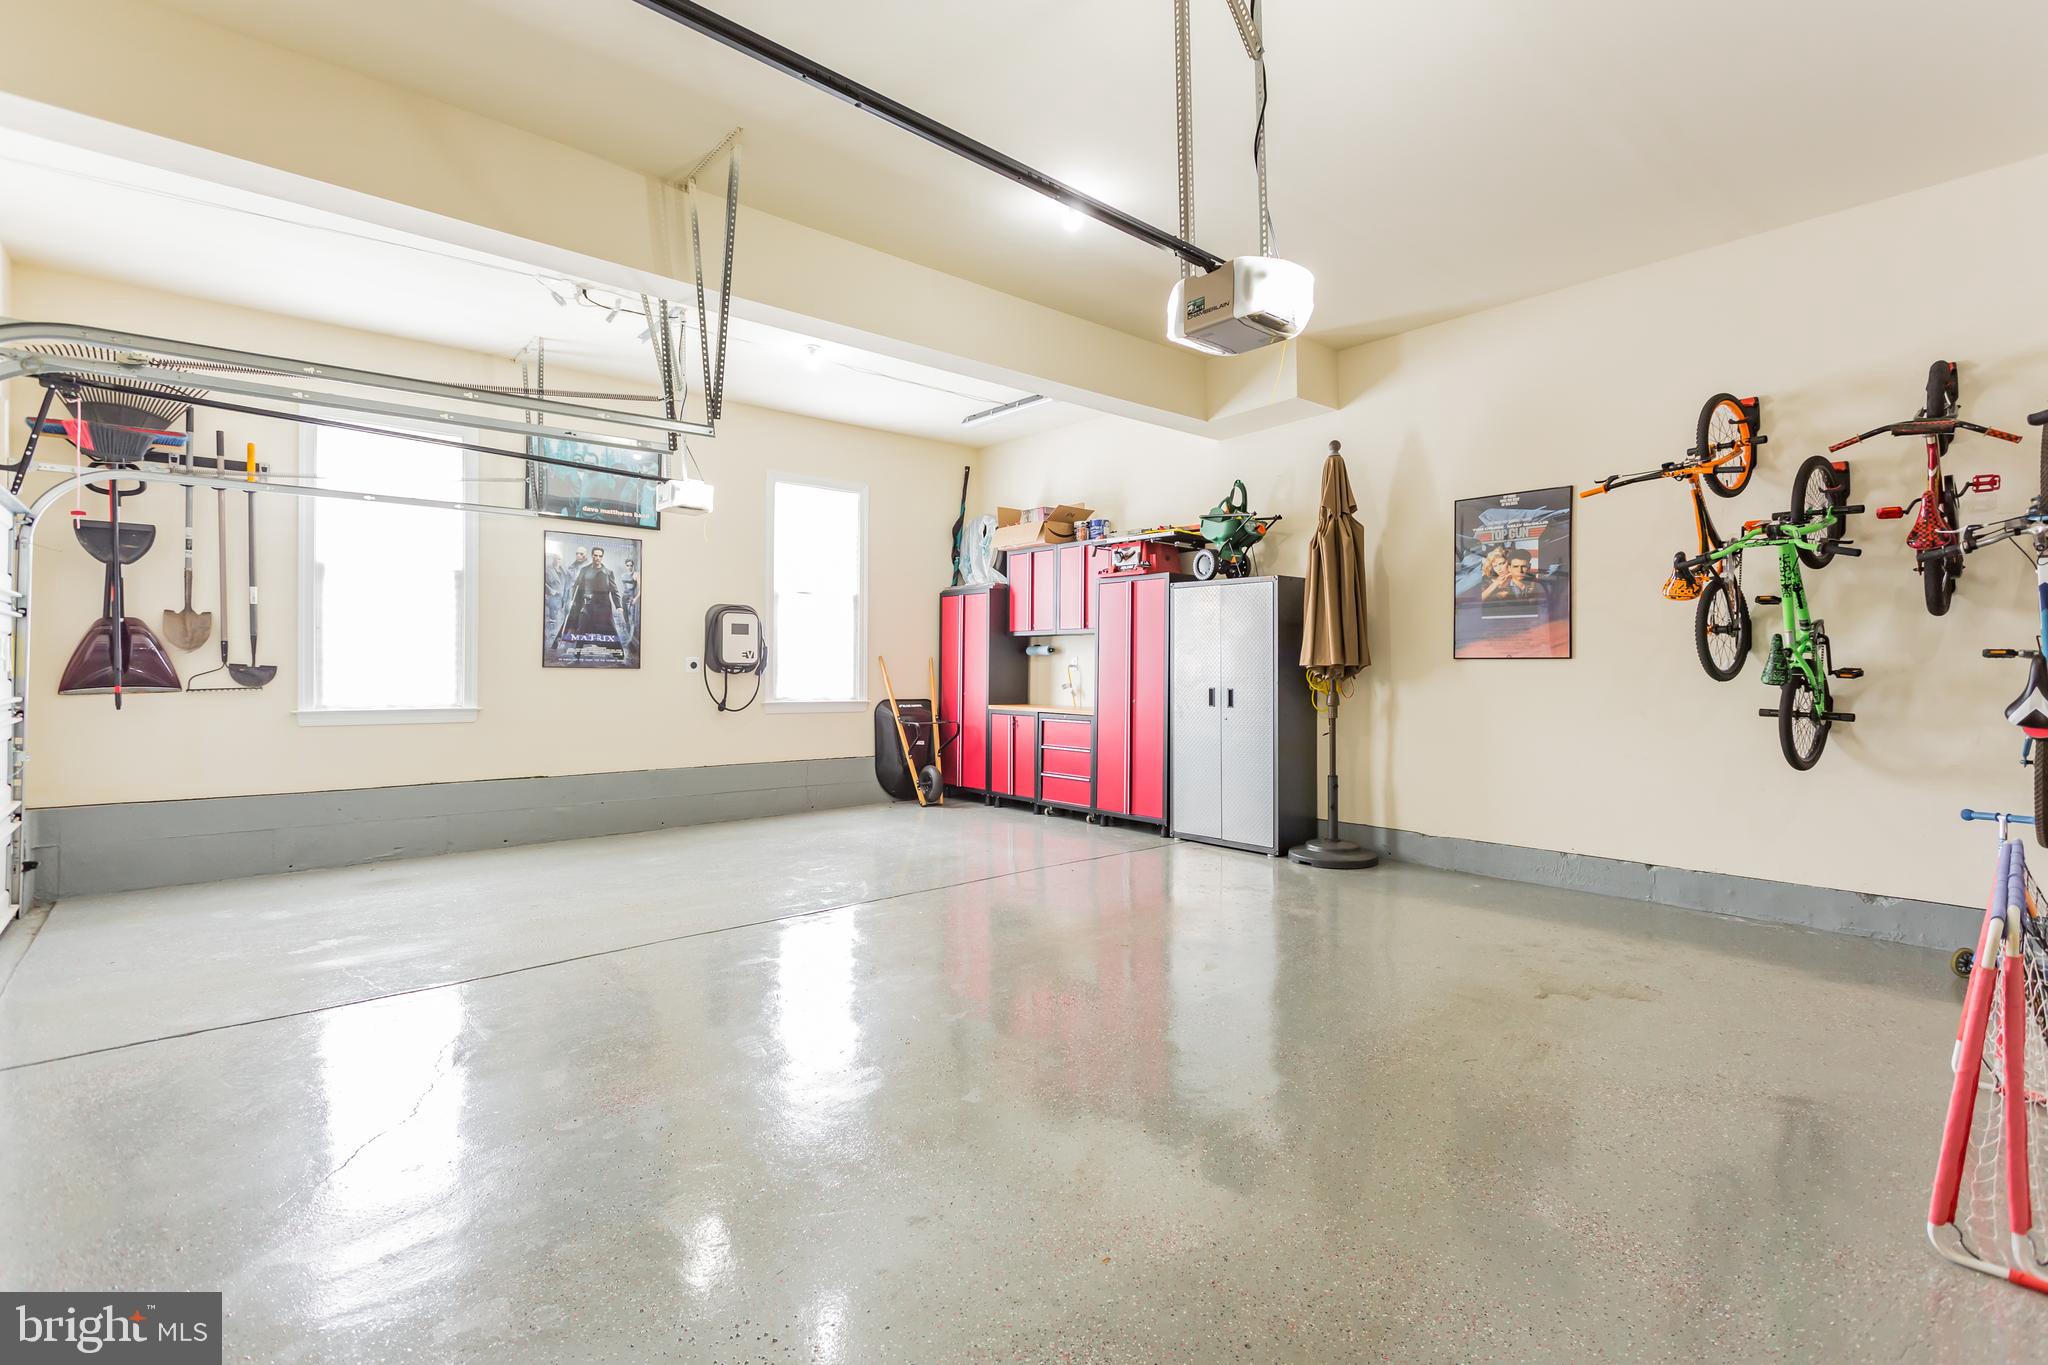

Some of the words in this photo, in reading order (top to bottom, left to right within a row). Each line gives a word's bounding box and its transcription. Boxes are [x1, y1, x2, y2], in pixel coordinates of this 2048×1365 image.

[1187, 301, 1230, 320] CHAMBERLAIN
[582, 505, 599, 513] dave
[600, 508, 633, 517] matthews
[1491, 529, 1507, 541] TOP
[1509, 527, 1529, 539] GUN
[571, 633, 615, 642] MATRIX
